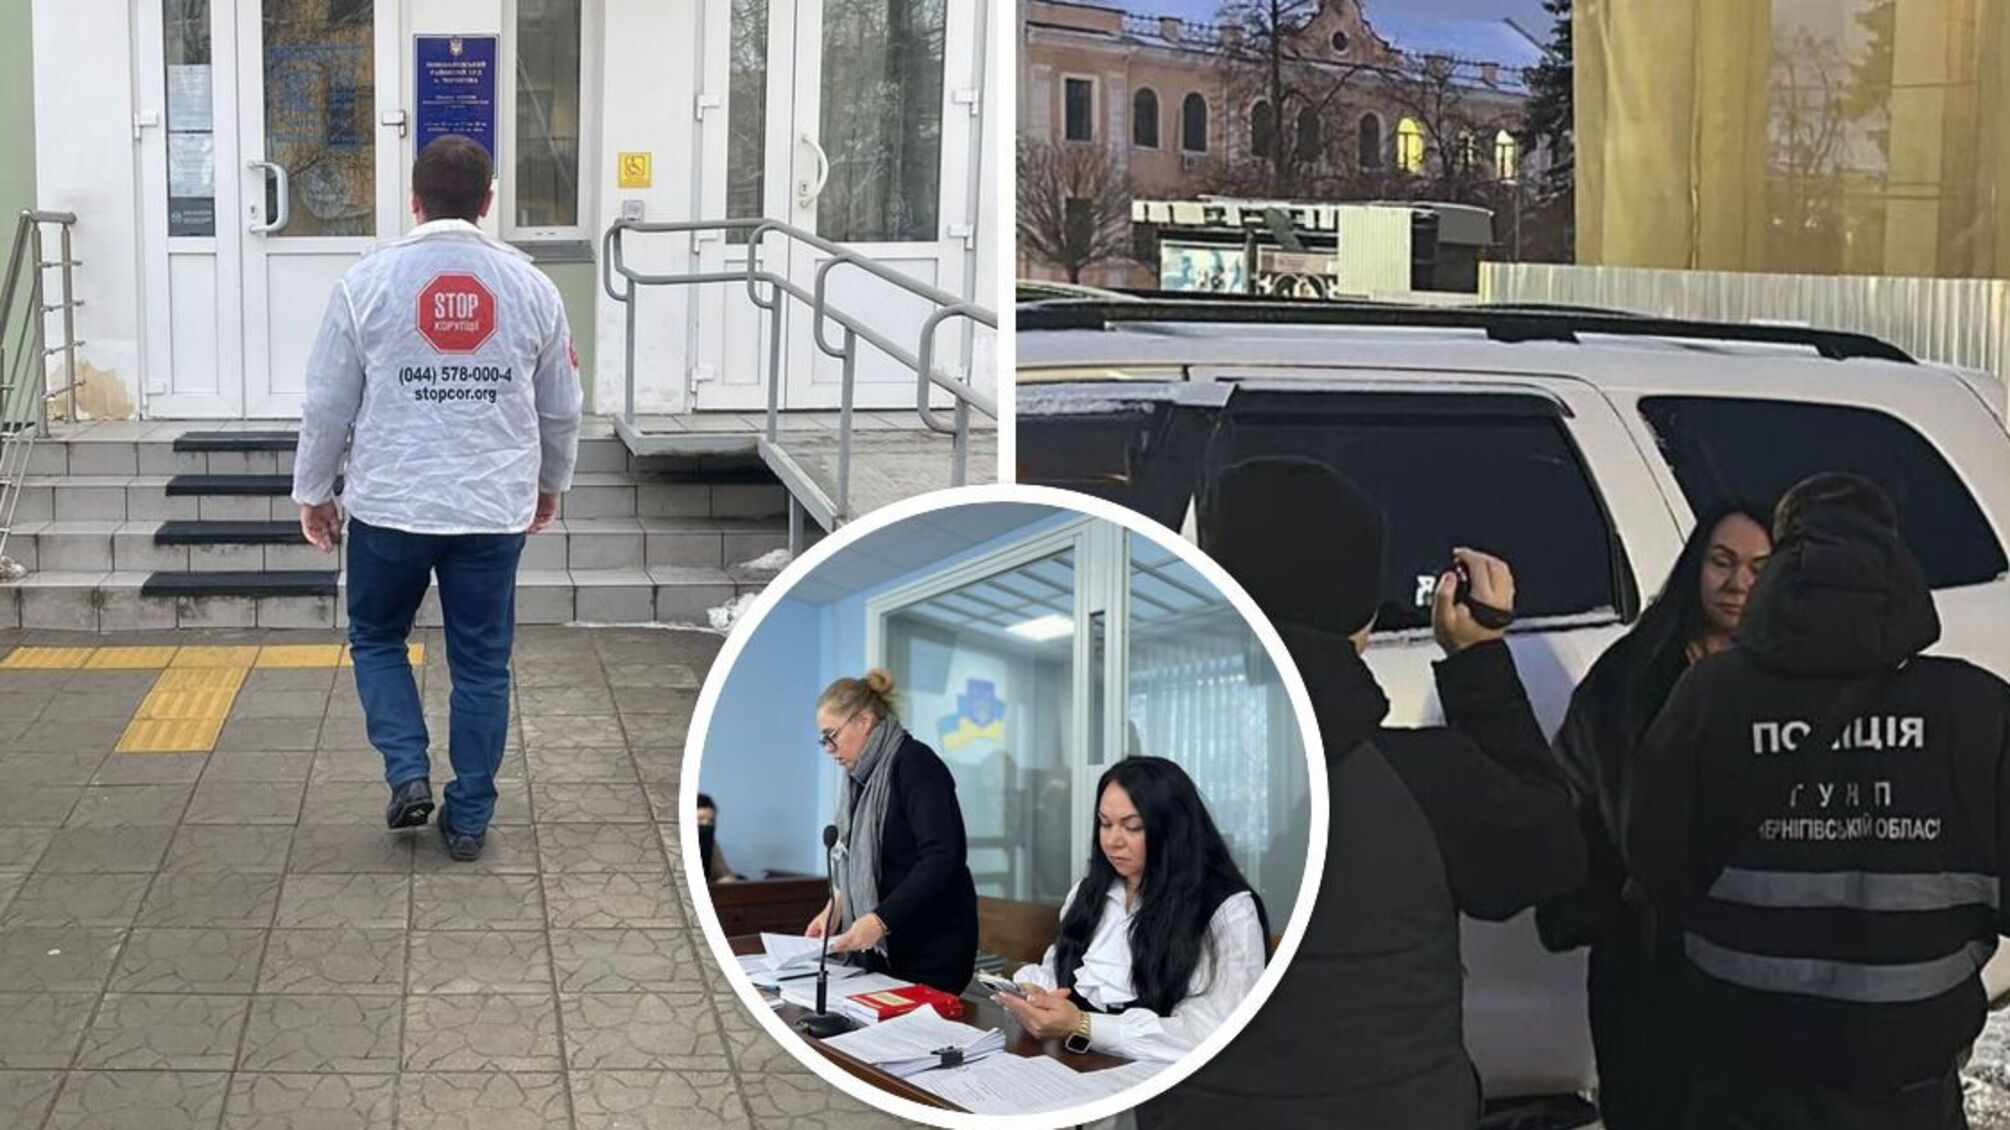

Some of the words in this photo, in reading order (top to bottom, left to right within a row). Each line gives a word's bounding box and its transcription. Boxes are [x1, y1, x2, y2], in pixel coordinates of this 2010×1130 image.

[434, 292, 479, 319] STOP
[399, 367, 437, 385] (044)
[441, 366, 513, 382] 578-000-4
[414, 386, 498, 403] stopcor.org
